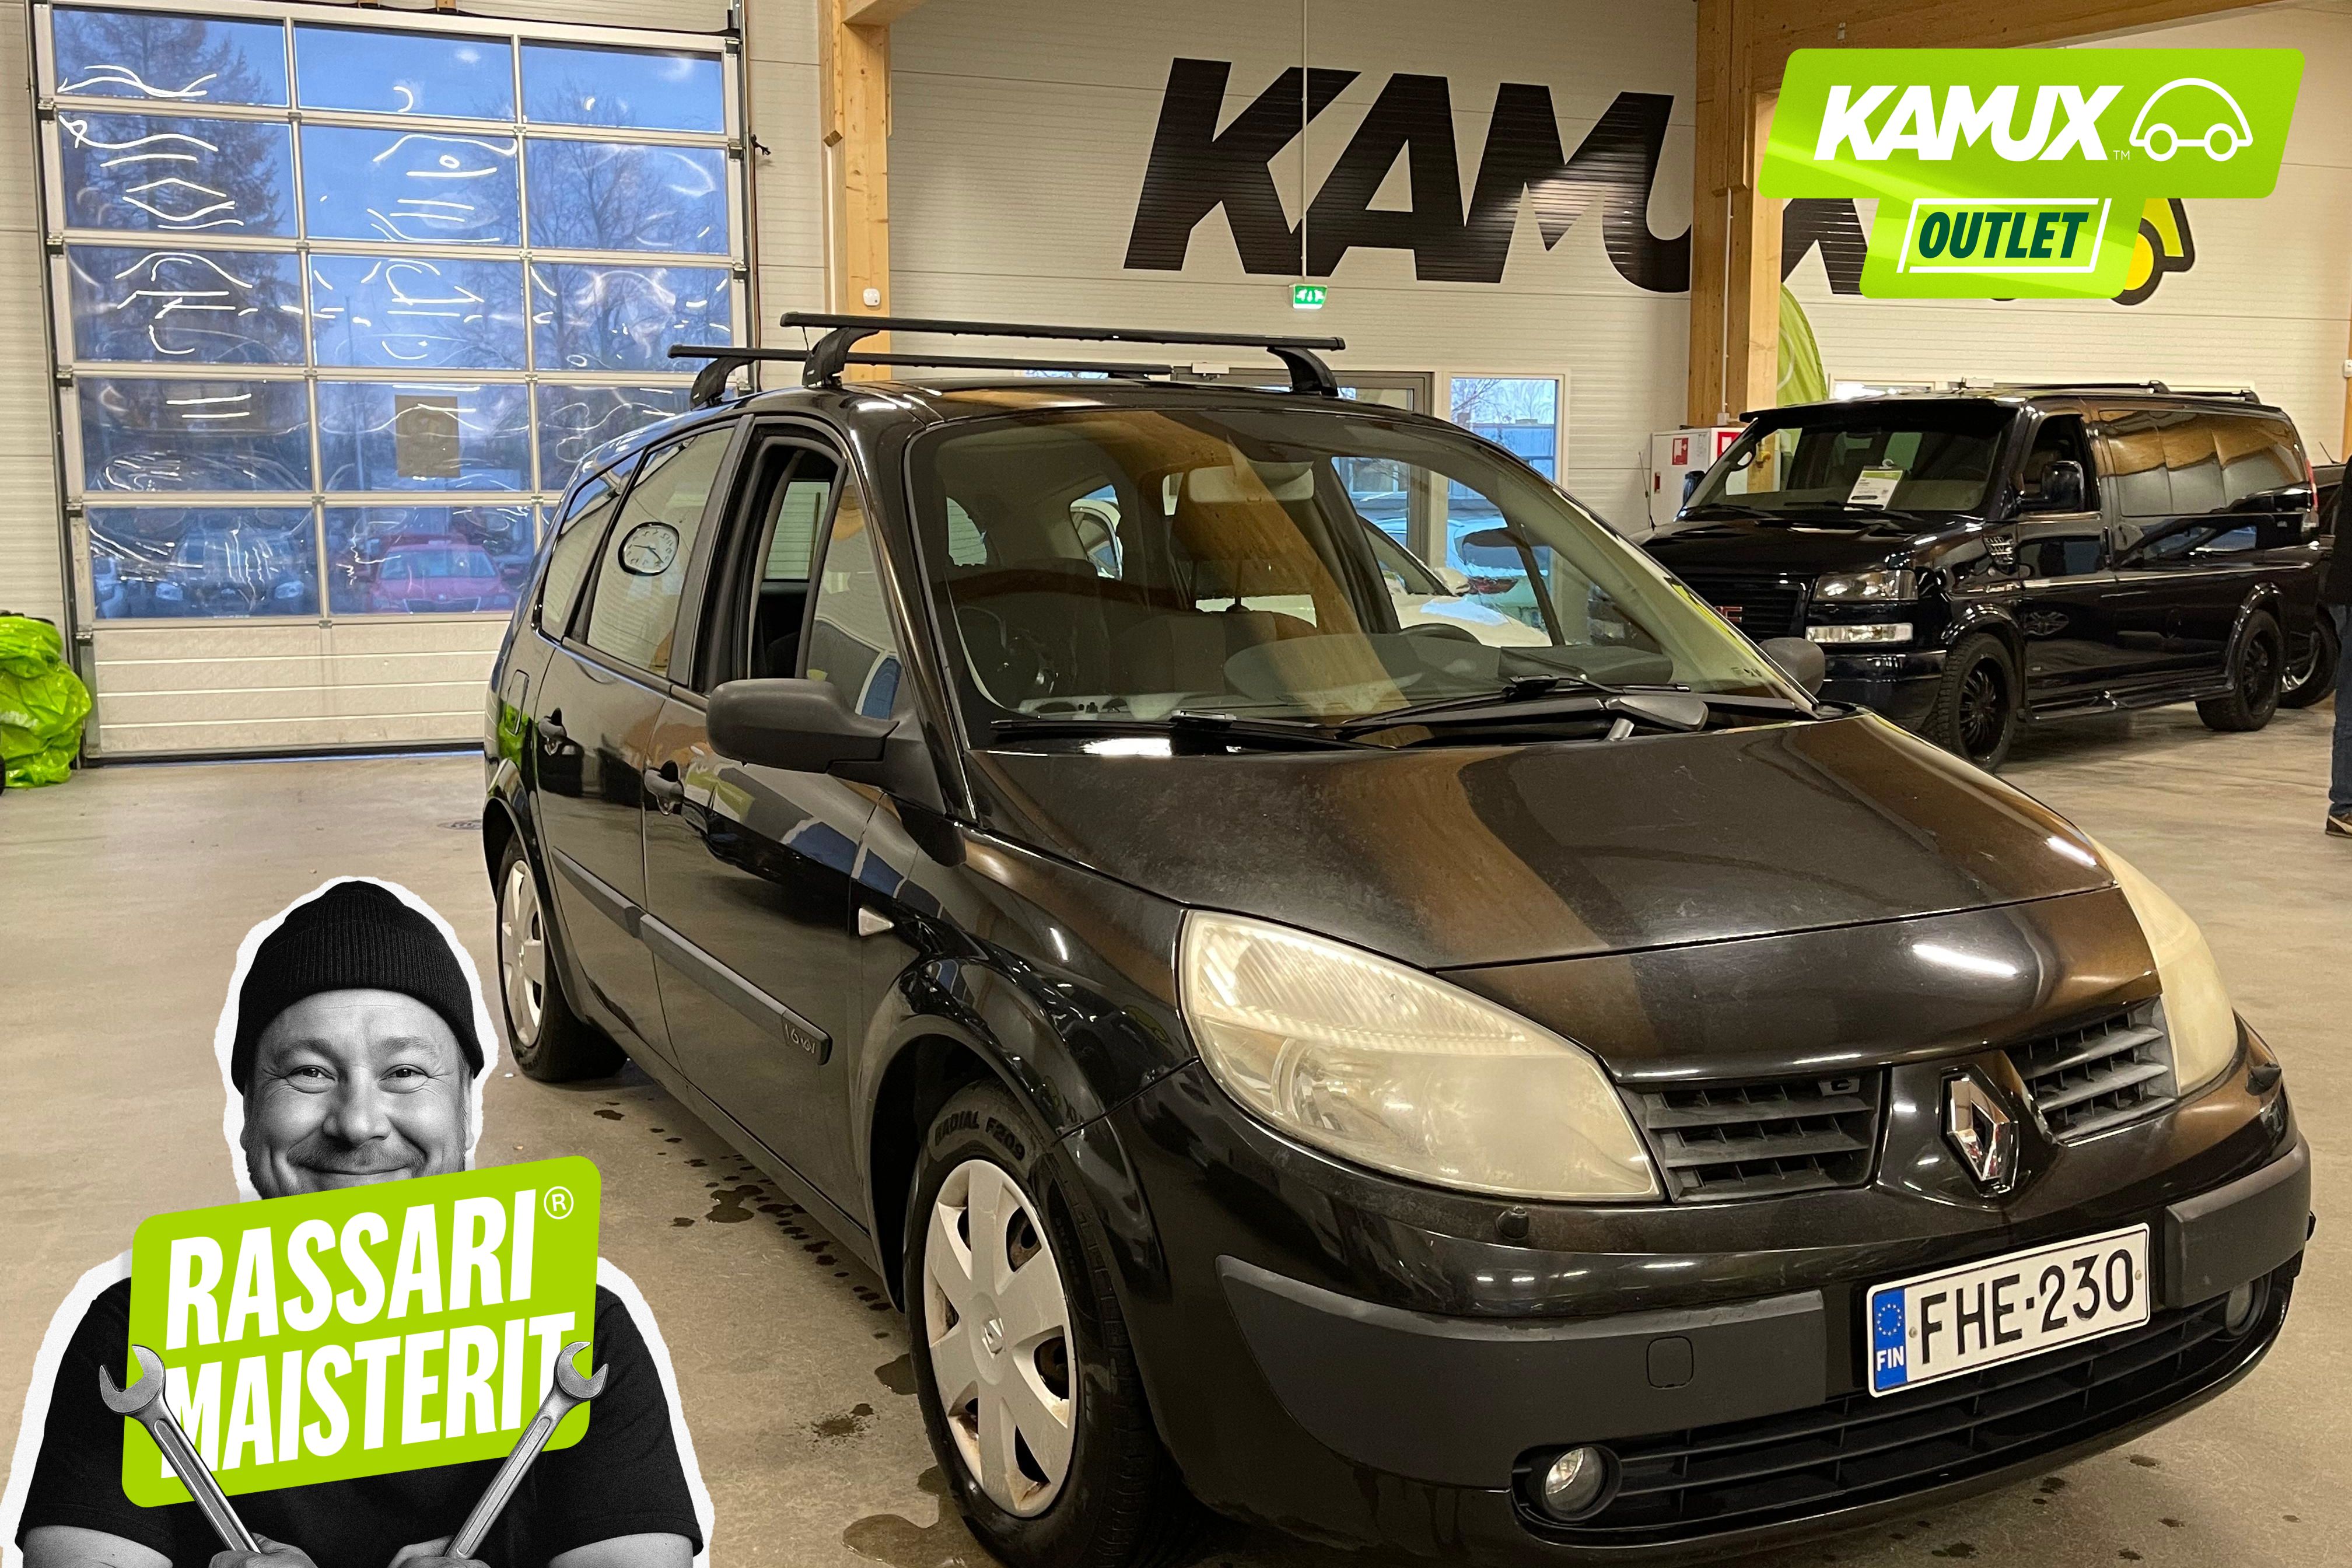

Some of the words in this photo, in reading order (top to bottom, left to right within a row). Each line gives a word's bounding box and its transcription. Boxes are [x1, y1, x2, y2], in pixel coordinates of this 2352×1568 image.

[935, 1110, 980, 1147] RADIAL
[1920, 1248, 2134, 1365] FHE-230
[1877, 1345, 1905, 1372] FIN
